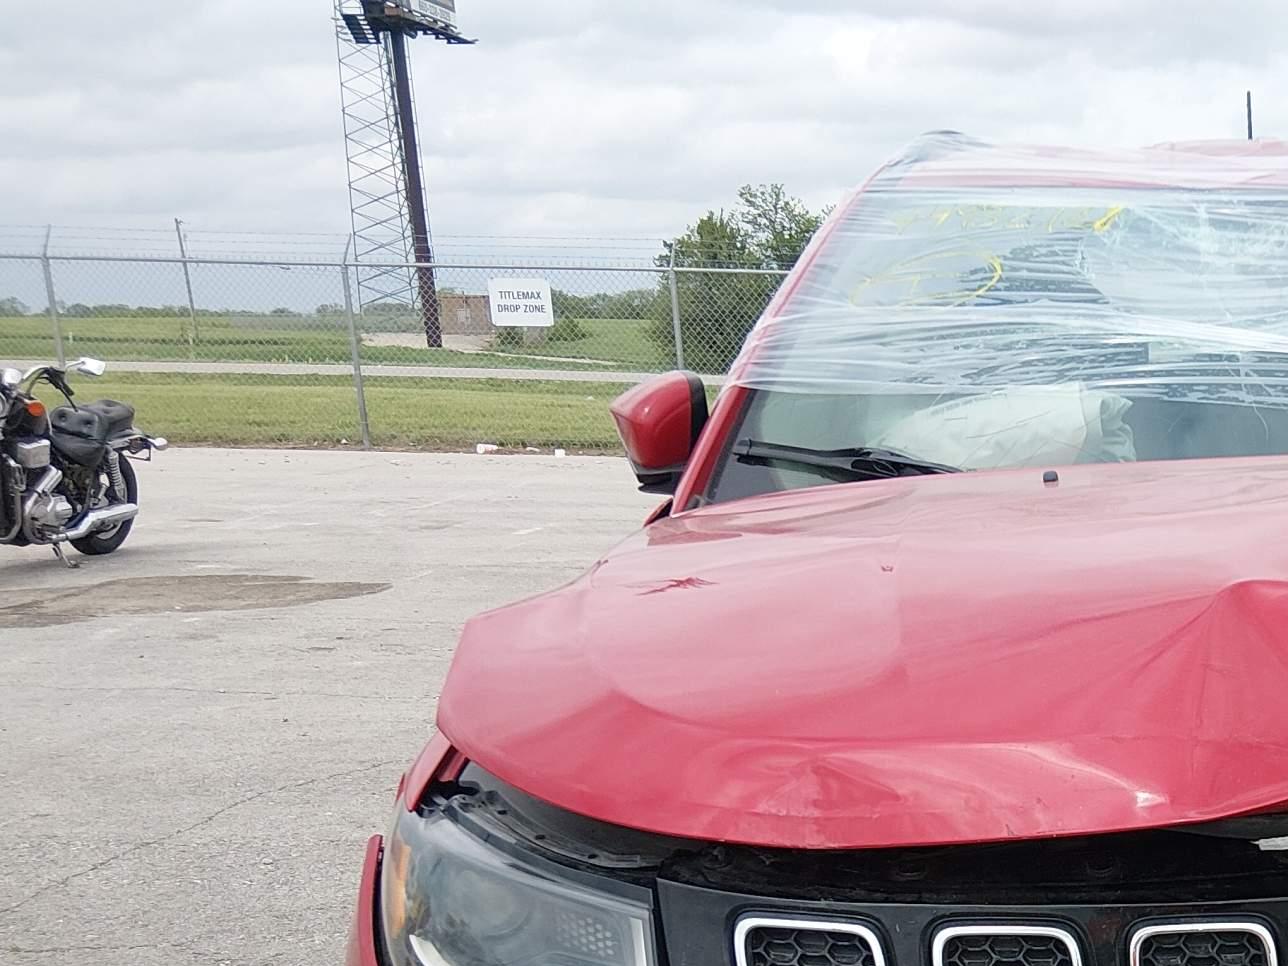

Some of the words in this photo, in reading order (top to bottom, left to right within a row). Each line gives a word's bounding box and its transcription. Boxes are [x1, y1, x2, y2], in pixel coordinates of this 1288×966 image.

[497, 290, 542, 300] TITLEMAX
[497, 303, 521, 313] DROP
[522, 304, 547, 314] ZONE
